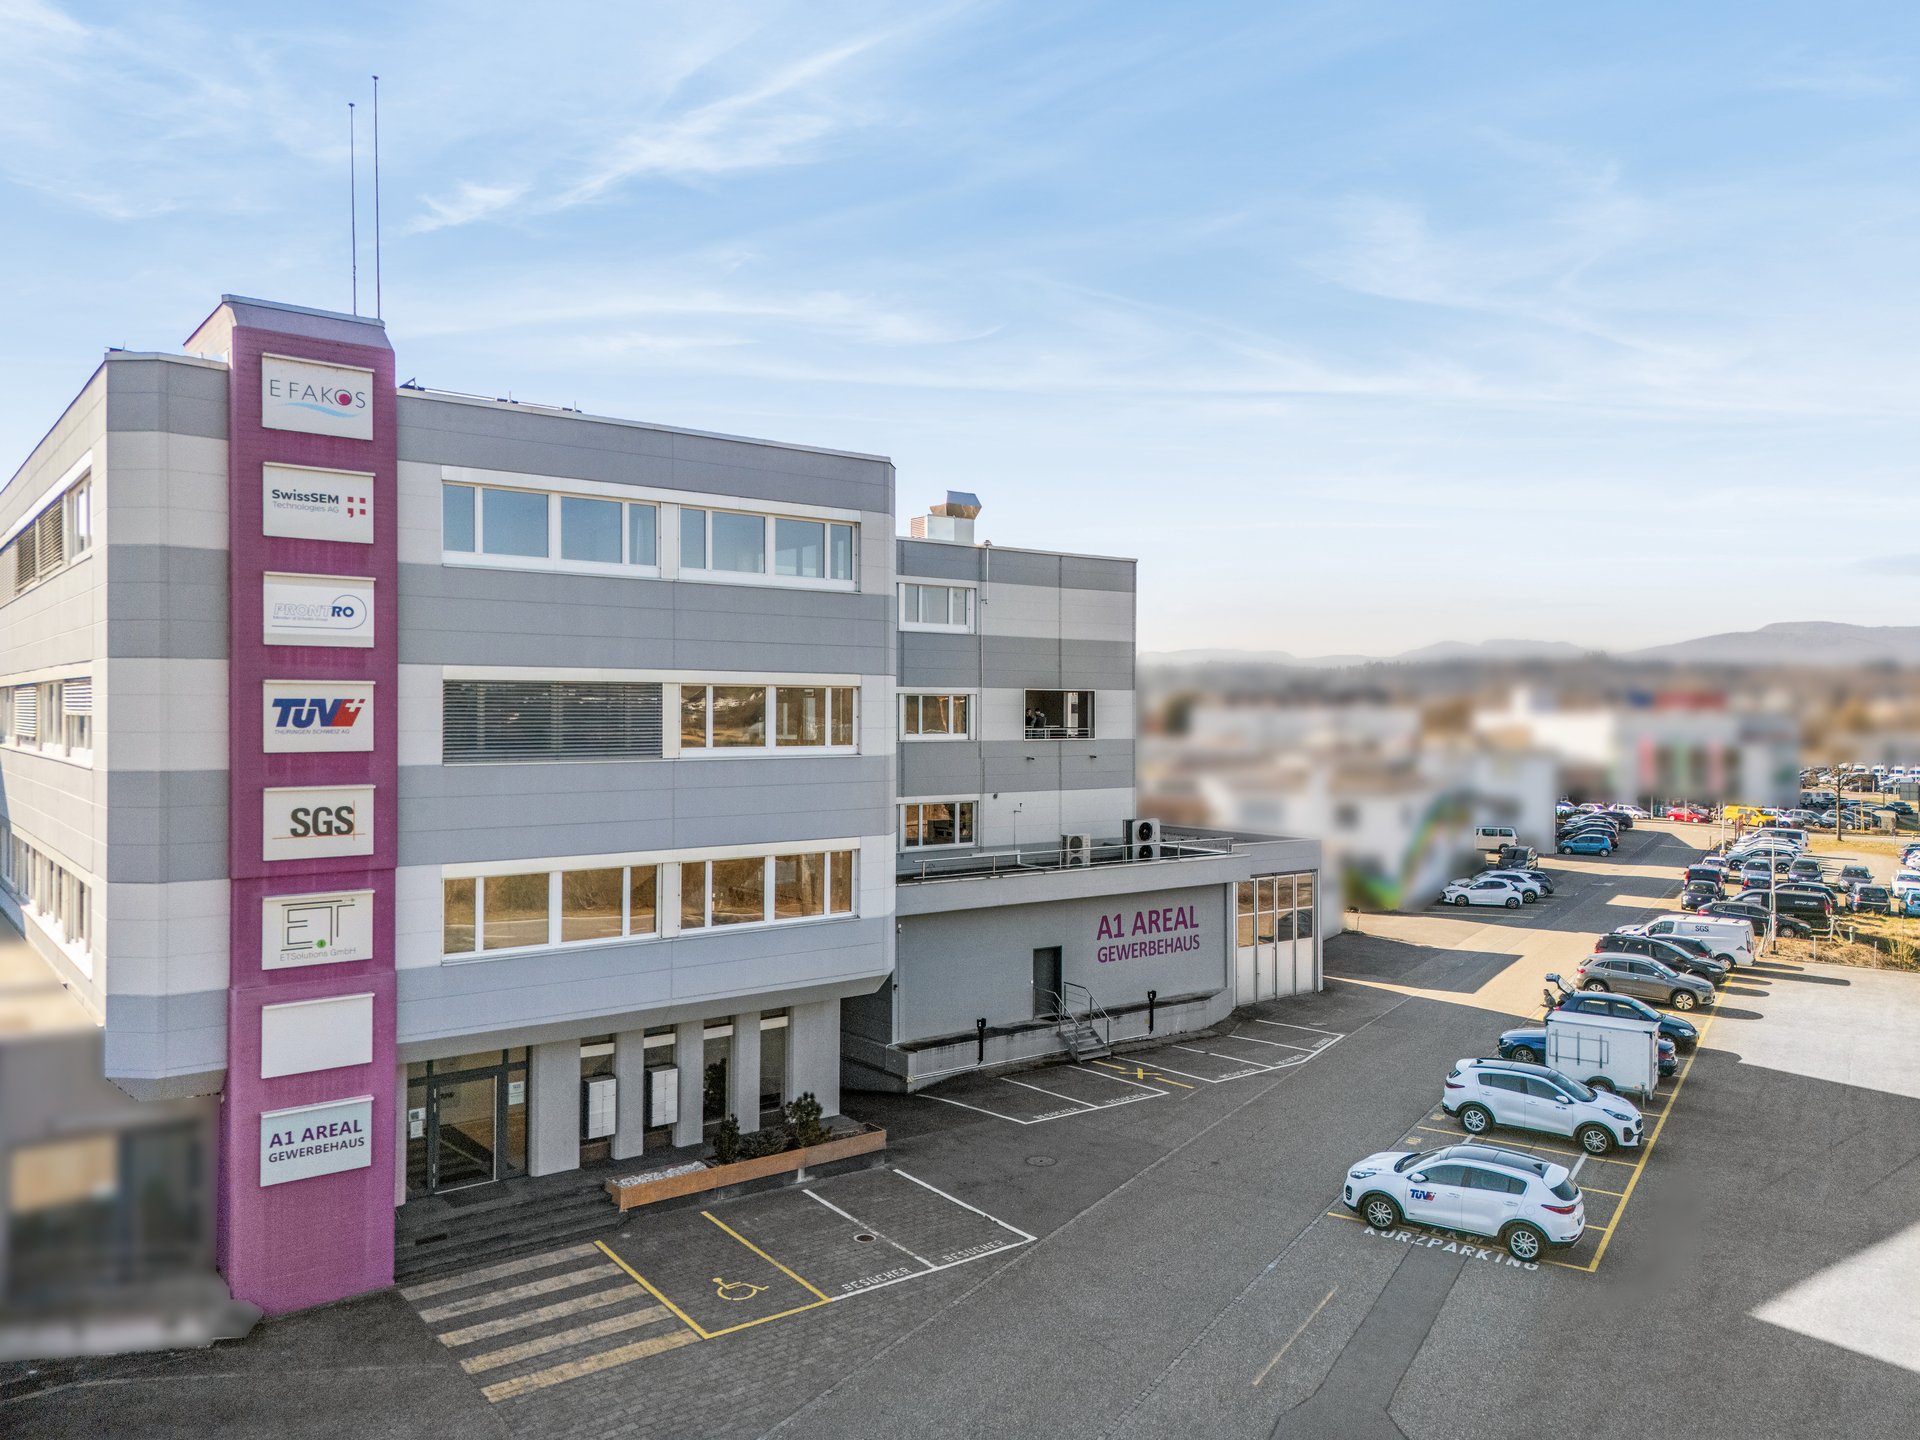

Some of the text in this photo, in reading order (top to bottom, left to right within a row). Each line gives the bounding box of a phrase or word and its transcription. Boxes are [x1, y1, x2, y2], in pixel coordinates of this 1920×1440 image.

[272, 489, 339, 505] SwissSEM
[273, 500, 340, 514] Technologies AG
[290, 805, 355, 838] SGS
[1096, 905, 1199, 941] A1 AREAL
[1694, 925, 1710, 933] SGS
[330, 947, 356, 957] GmbH
[1097, 934, 1201, 963] GEWERBEHAUS
[269, 1119, 363, 1148] A1 AREAL
[268, 1136, 365, 1163] GEWERBEHAUS
[942, 1239, 1007, 1262] BESUCHER
[841, 1267, 913, 1292] BESUCHER
